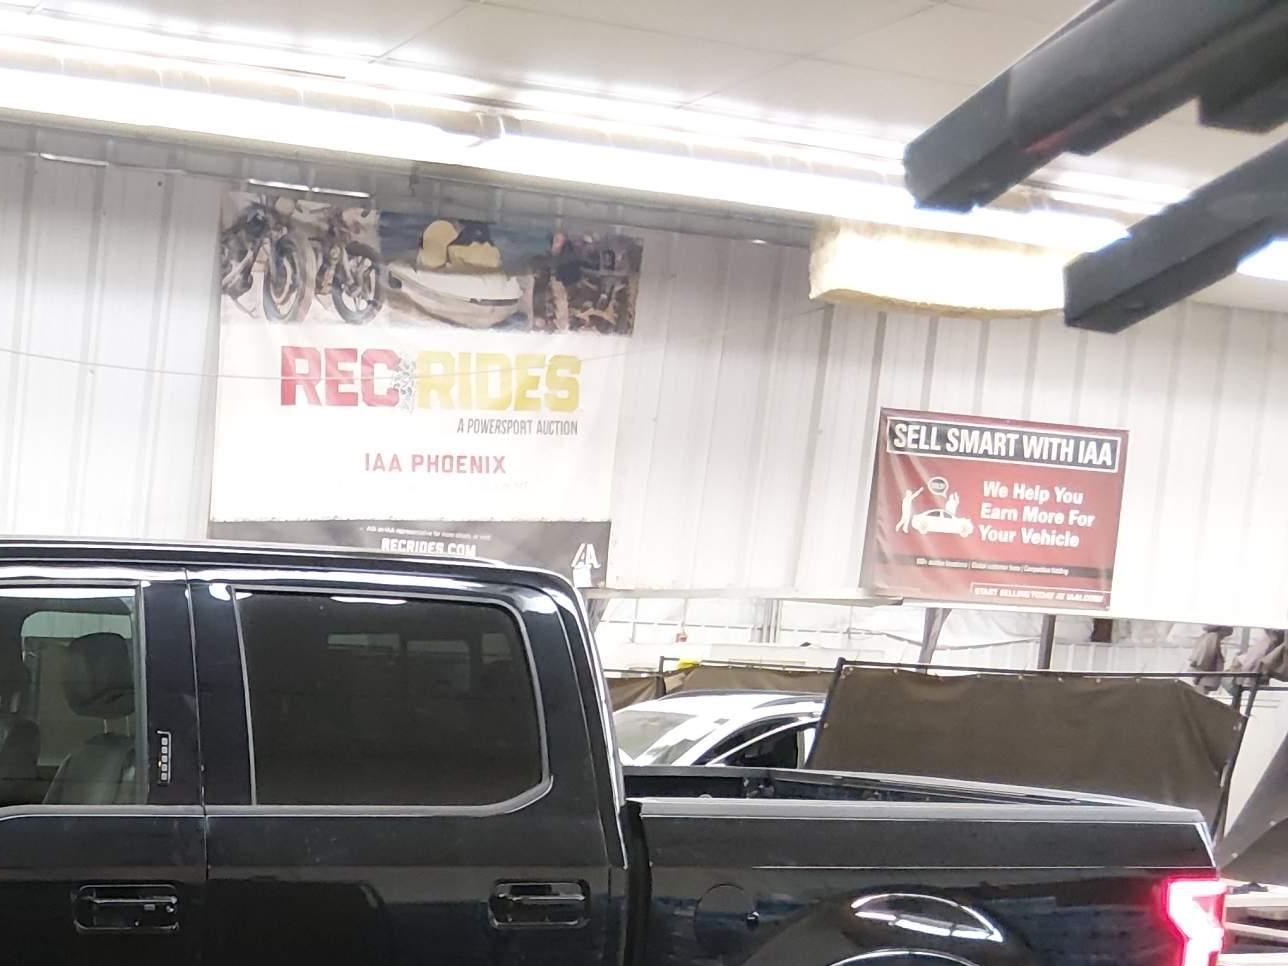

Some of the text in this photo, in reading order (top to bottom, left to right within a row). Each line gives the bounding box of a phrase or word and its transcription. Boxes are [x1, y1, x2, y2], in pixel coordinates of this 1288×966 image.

[280, 345, 583, 413] REC RIDES
[457, 417, 579, 436] A POWERSPORT AUCTION
[893, 423, 1113, 467] SELL SMART WITH IAA
[365, 453, 507, 475] IAA PHOENIX
[983, 480, 1084, 505] We Help You
[980, 502, 1096, 528] Earn More For
[381, 537, 477, 557] RECRIDESCOM
[978, 524, 1080, 548] Your Vehicle
